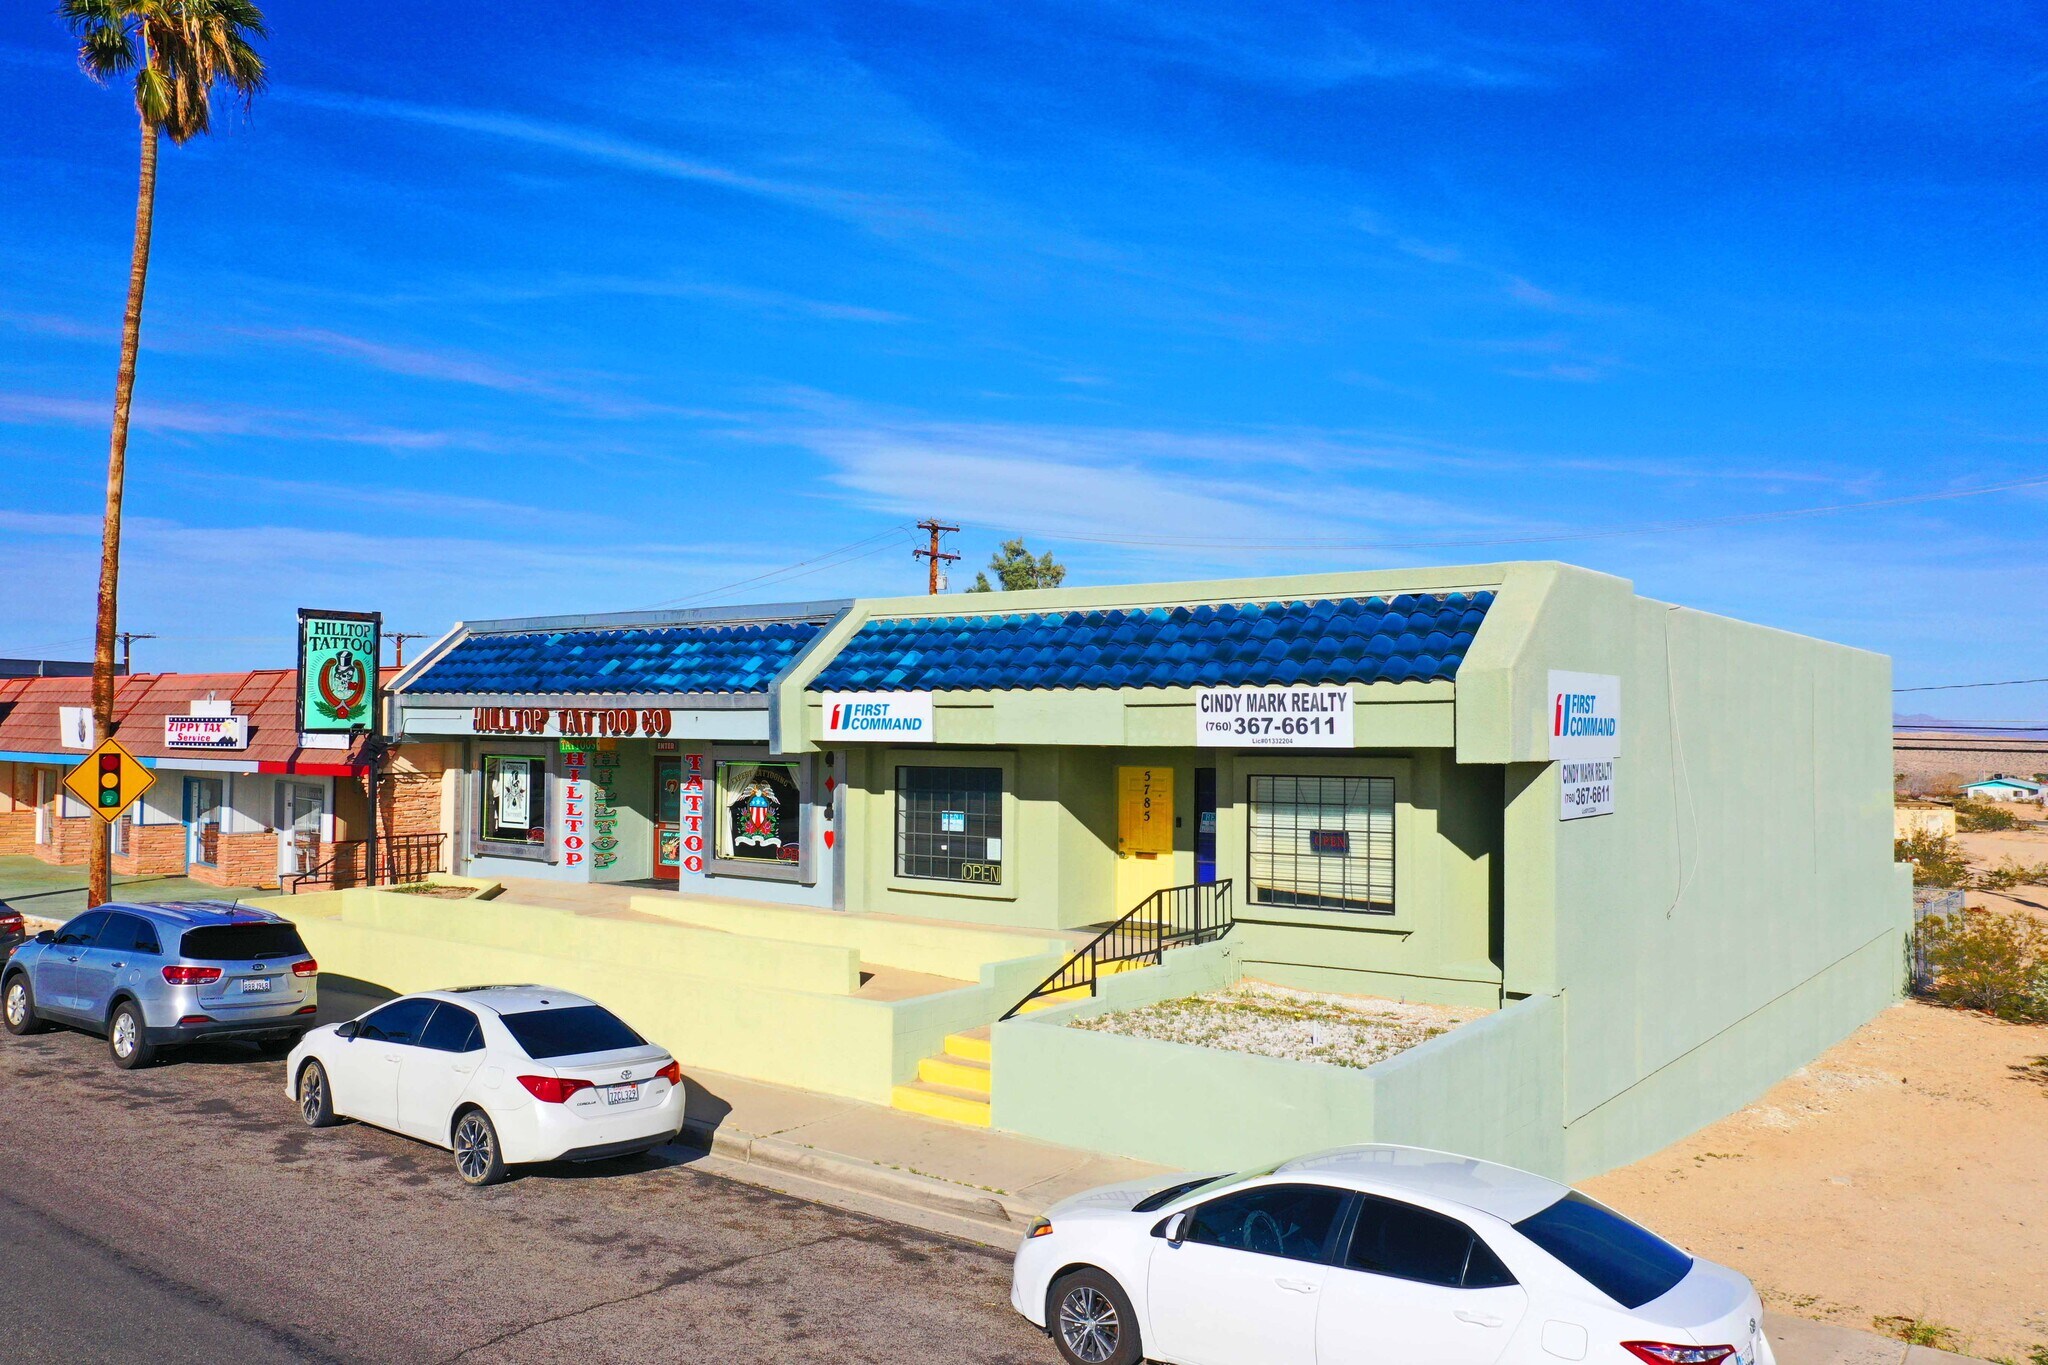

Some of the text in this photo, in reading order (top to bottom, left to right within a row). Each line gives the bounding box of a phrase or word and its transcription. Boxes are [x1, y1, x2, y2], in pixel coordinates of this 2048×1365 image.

[314, 621, 371, 638] HILLTOP
[309, 636, 373, 655] TATTOO
[854, 703, 890, 716] FIRST
[1201, 692, 1347, 713] CINDY MARK REALTY
[1571, 694, 1596, 714] FIRST
[168, 722, 222, 732] ZIPPY TAX
[472, 707, 671, 737] HILLTOP TATTOO CO
[851, 717, 922, 730] COMMAND
[1205, 716, 1335, 735] (760) 367-6611
[1570, 716, 1616, 737] COMMAND
[177, 732, 211, 742] Service
[1143, 770, 1151, 821] 5785
[1576, 785, 1610, 805] 367-6611
[564, 752, 586, 866] HILLTOP
[684, 754, 704, 872] TATTOO
[963, 864, 999, 882] OPEN
